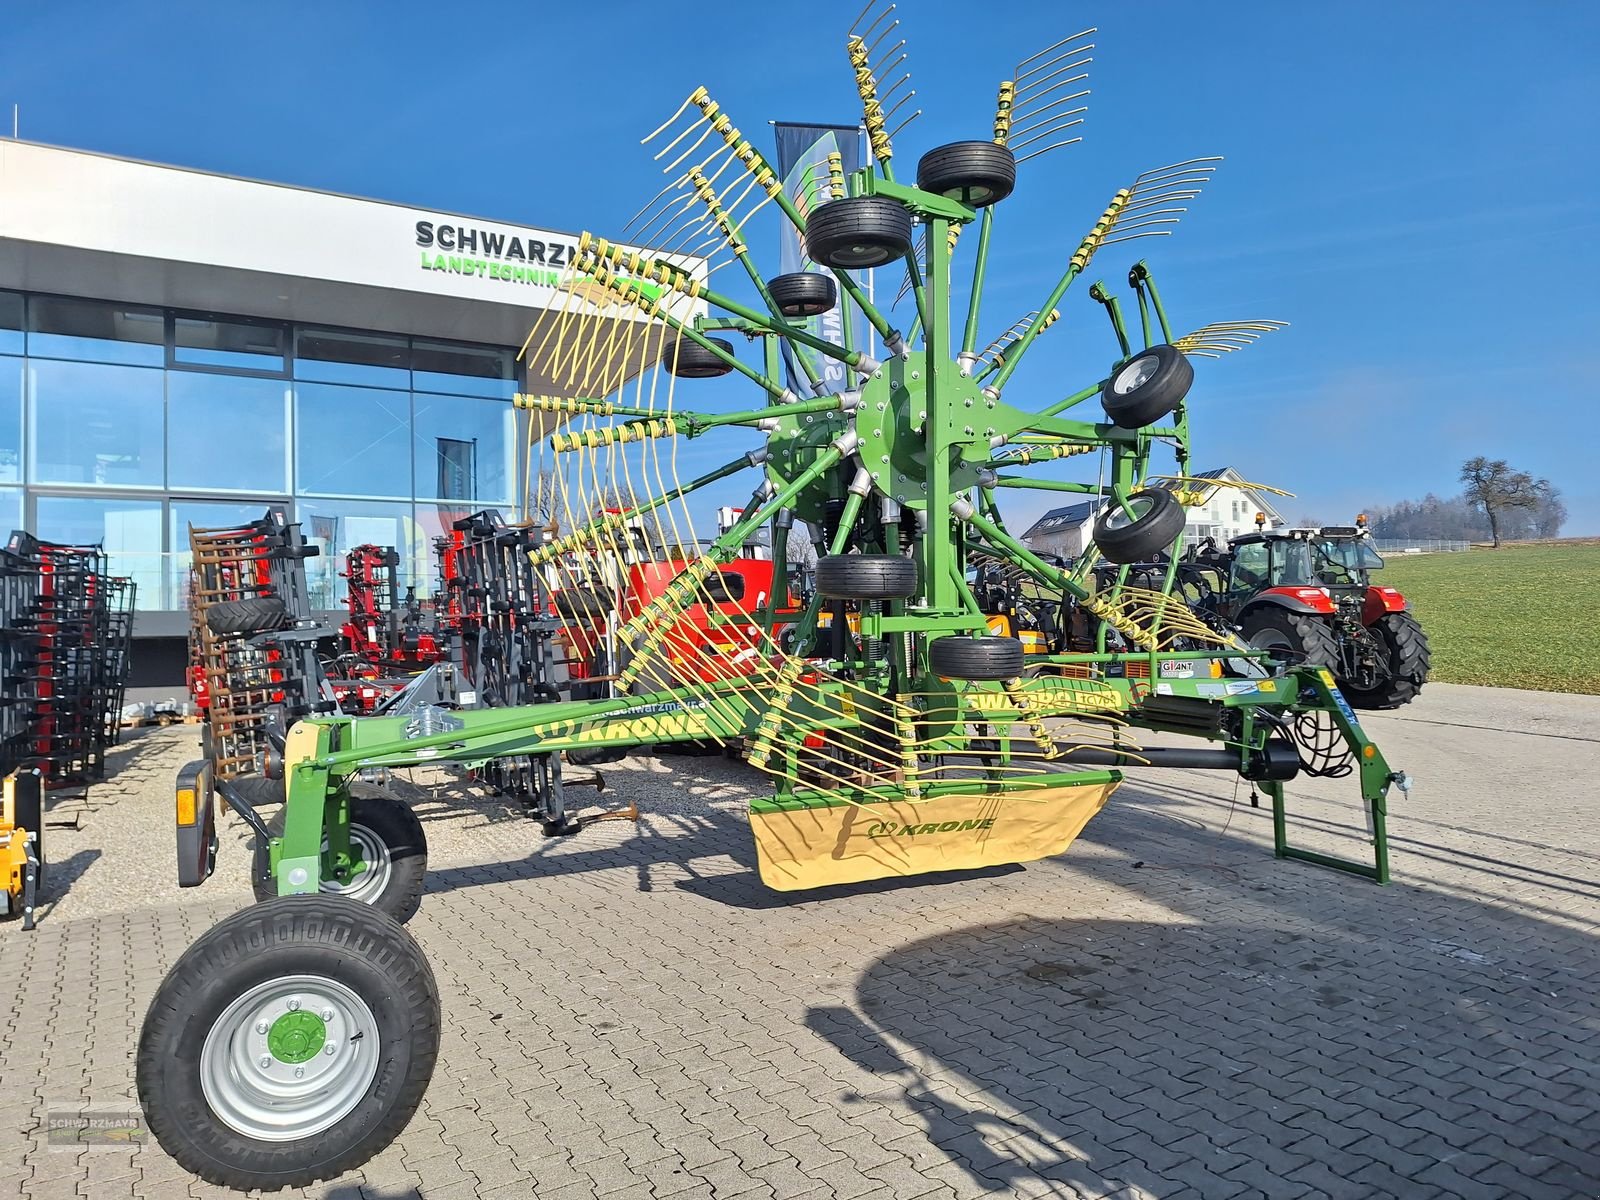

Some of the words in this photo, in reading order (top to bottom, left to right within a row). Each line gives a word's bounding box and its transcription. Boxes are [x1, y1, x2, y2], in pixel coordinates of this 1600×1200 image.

[415, 221, 643, 277] SCHWARZ
[420, 252, 559, 289] LANDTECHNIK
[577, 713, 708, 742] KRONE
[898, 817, 997, 837] KRONE
